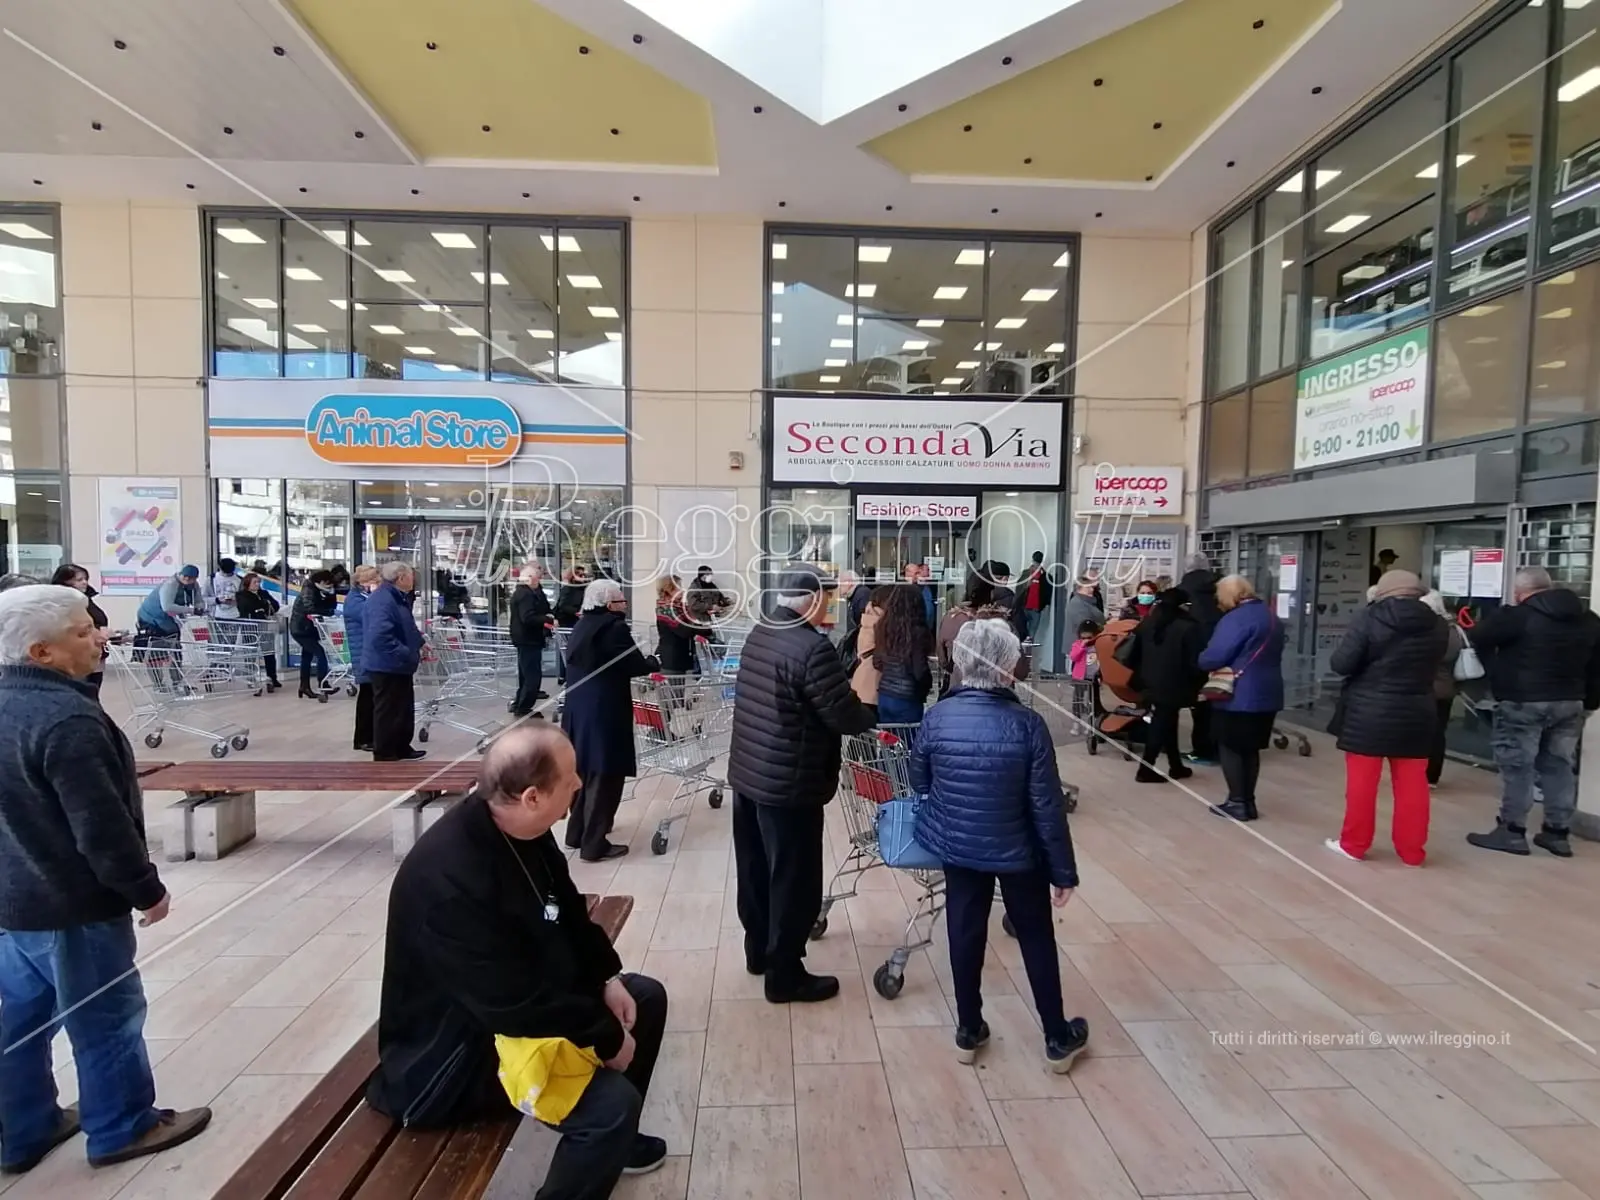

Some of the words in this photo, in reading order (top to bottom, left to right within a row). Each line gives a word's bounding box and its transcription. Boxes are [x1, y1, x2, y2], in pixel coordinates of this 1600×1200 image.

[1303, 341, 1419, 399] INGRESSO
[1369, 378, 1415, 401] ipercoop
[318, 408, 424, 448] Animal
[425, 411, 509, 449] Store
[786, 422, 972, 457] Seconda
[953, 421, 1051, 459] Via
[1314, 436, 1342, 457] 9:00
[1356, 421, 1400, 448] 21:00
[857, 458, 903, 467] ACCESSORI
[905, 459, 954, 468] CALZATURE
[957, 460, 980, 468] UOMO
[983, 460, 1011, 469] DONNA
[1013, 461, 1051, 469] BAMBINO
[1095, 473, 1168, 493] ipercoop
[862, 502, 921, 517] Fashion
[927, 503, 970, 517] Store
[1093, 496, 1146, 506] ENTRATA
